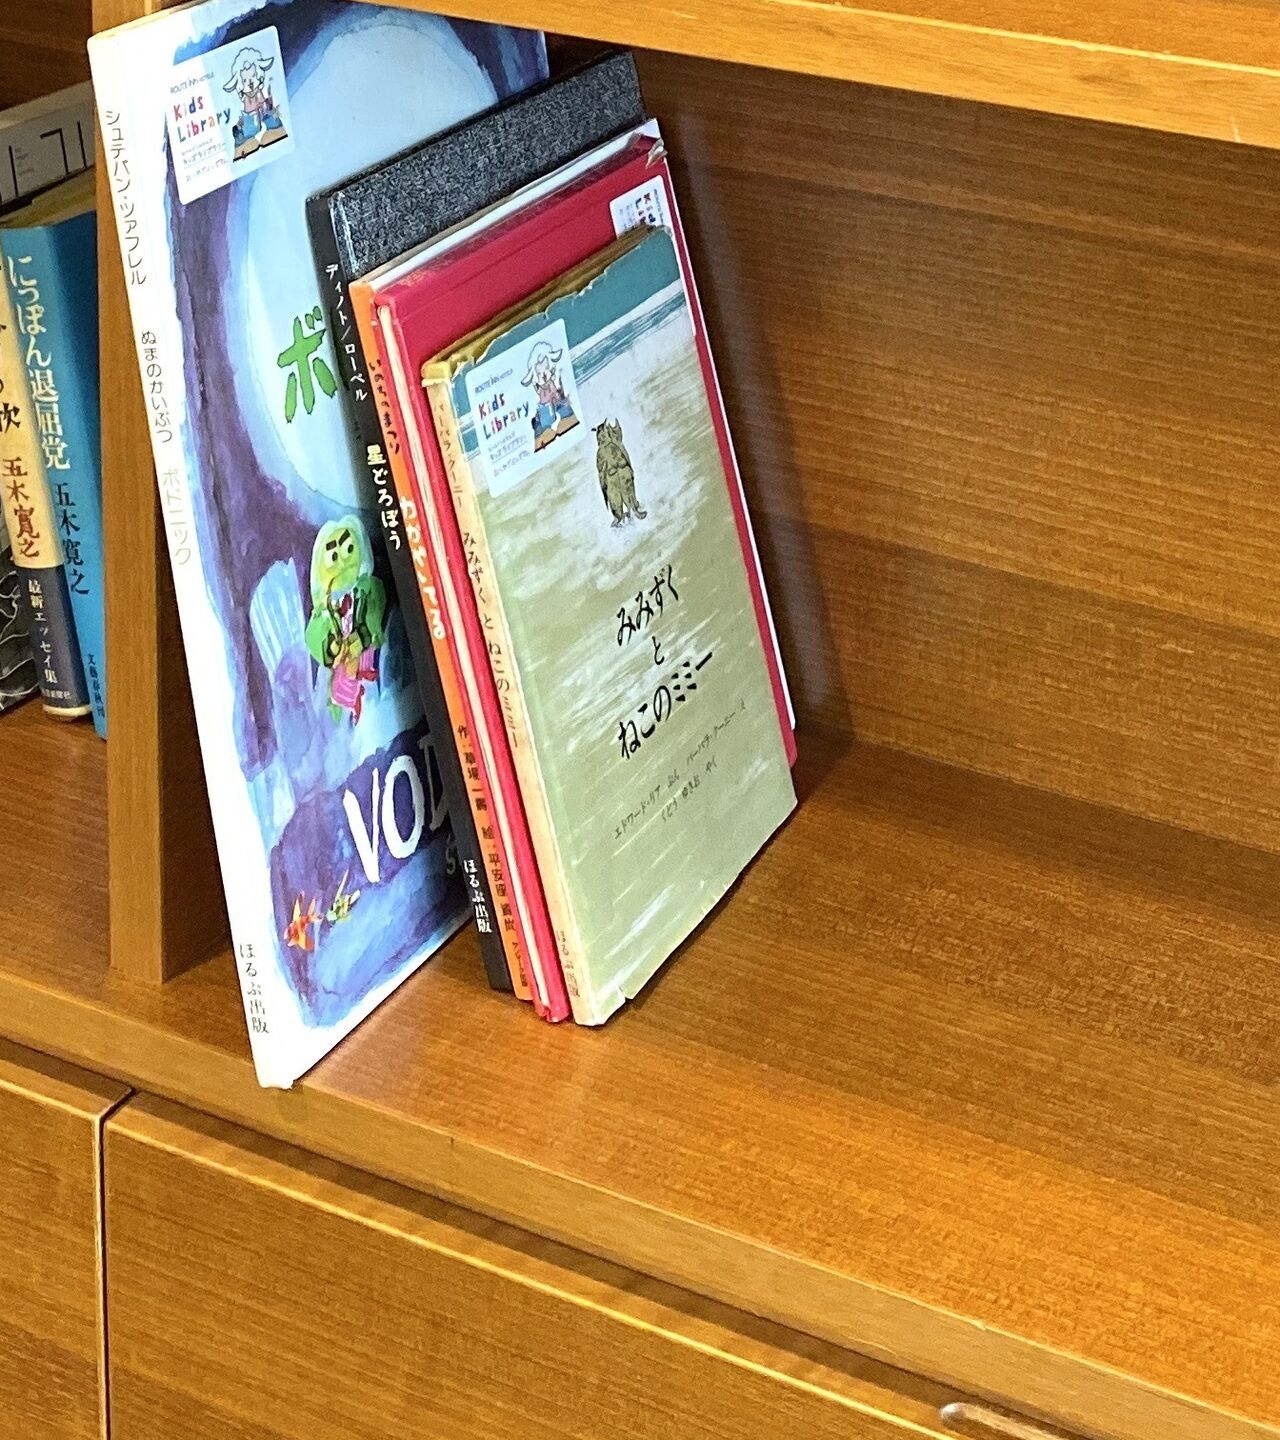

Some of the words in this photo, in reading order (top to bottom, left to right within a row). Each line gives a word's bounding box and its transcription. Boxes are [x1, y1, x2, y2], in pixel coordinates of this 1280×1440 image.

[173, 95, 205, 123] Kids
[177, 107, 232, 144] Library
[478, 391, 506, 419] Kids
[483, 399, 530, 440] Library
[1, 455, 40, 560] 五木寛之
[54, 481, 90, 596] 五木寛之
[463, 532, 488, 605] みみずく
[616, 563, 680, 647] みみずく
[483, 613, 495, 630] と
[651, 636, 666, 666] と
[141, 330, 173, 444] ぬまのかいぶつ
[238, 942, 270, 1034] ほるぷ出版
[367, 444, 402, 551] 星どろぼう
[463, 859, 492, 934] ほるぷ出版
[488, 639, 519, 748] ねこのミミー
[618, 650, 713, 761] ねこのミミー
